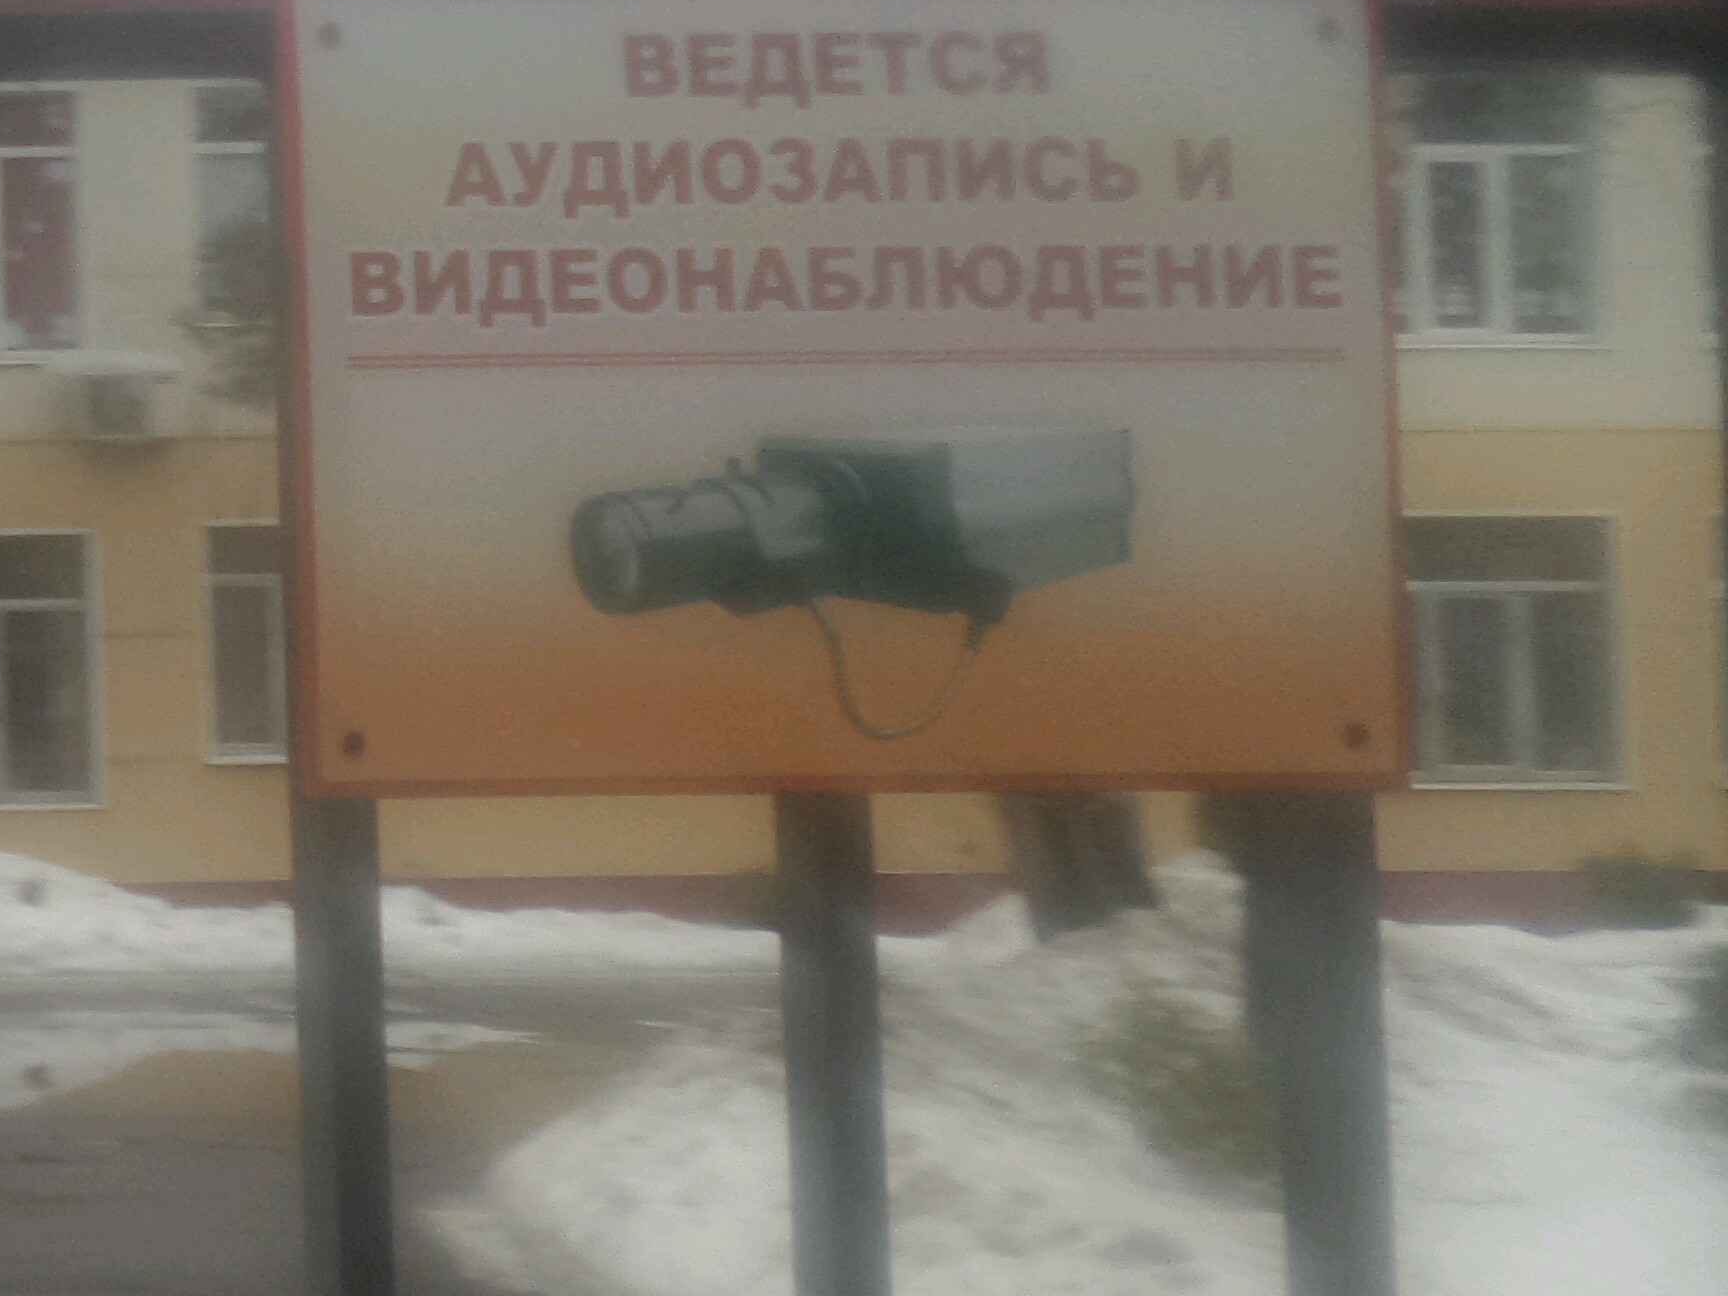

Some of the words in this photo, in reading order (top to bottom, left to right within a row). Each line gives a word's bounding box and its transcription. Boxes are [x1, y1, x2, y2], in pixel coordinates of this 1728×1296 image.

[622, 30, 1051, 107] ВЕДЕТСЯ
[445, 136, 1139, 219] АУДИОЗАПИСЬ
[1176, 137, 1235, 201] И
[350, 244, 1342, 327] ВИДЕОНАБЛЮДЕНИЕ
